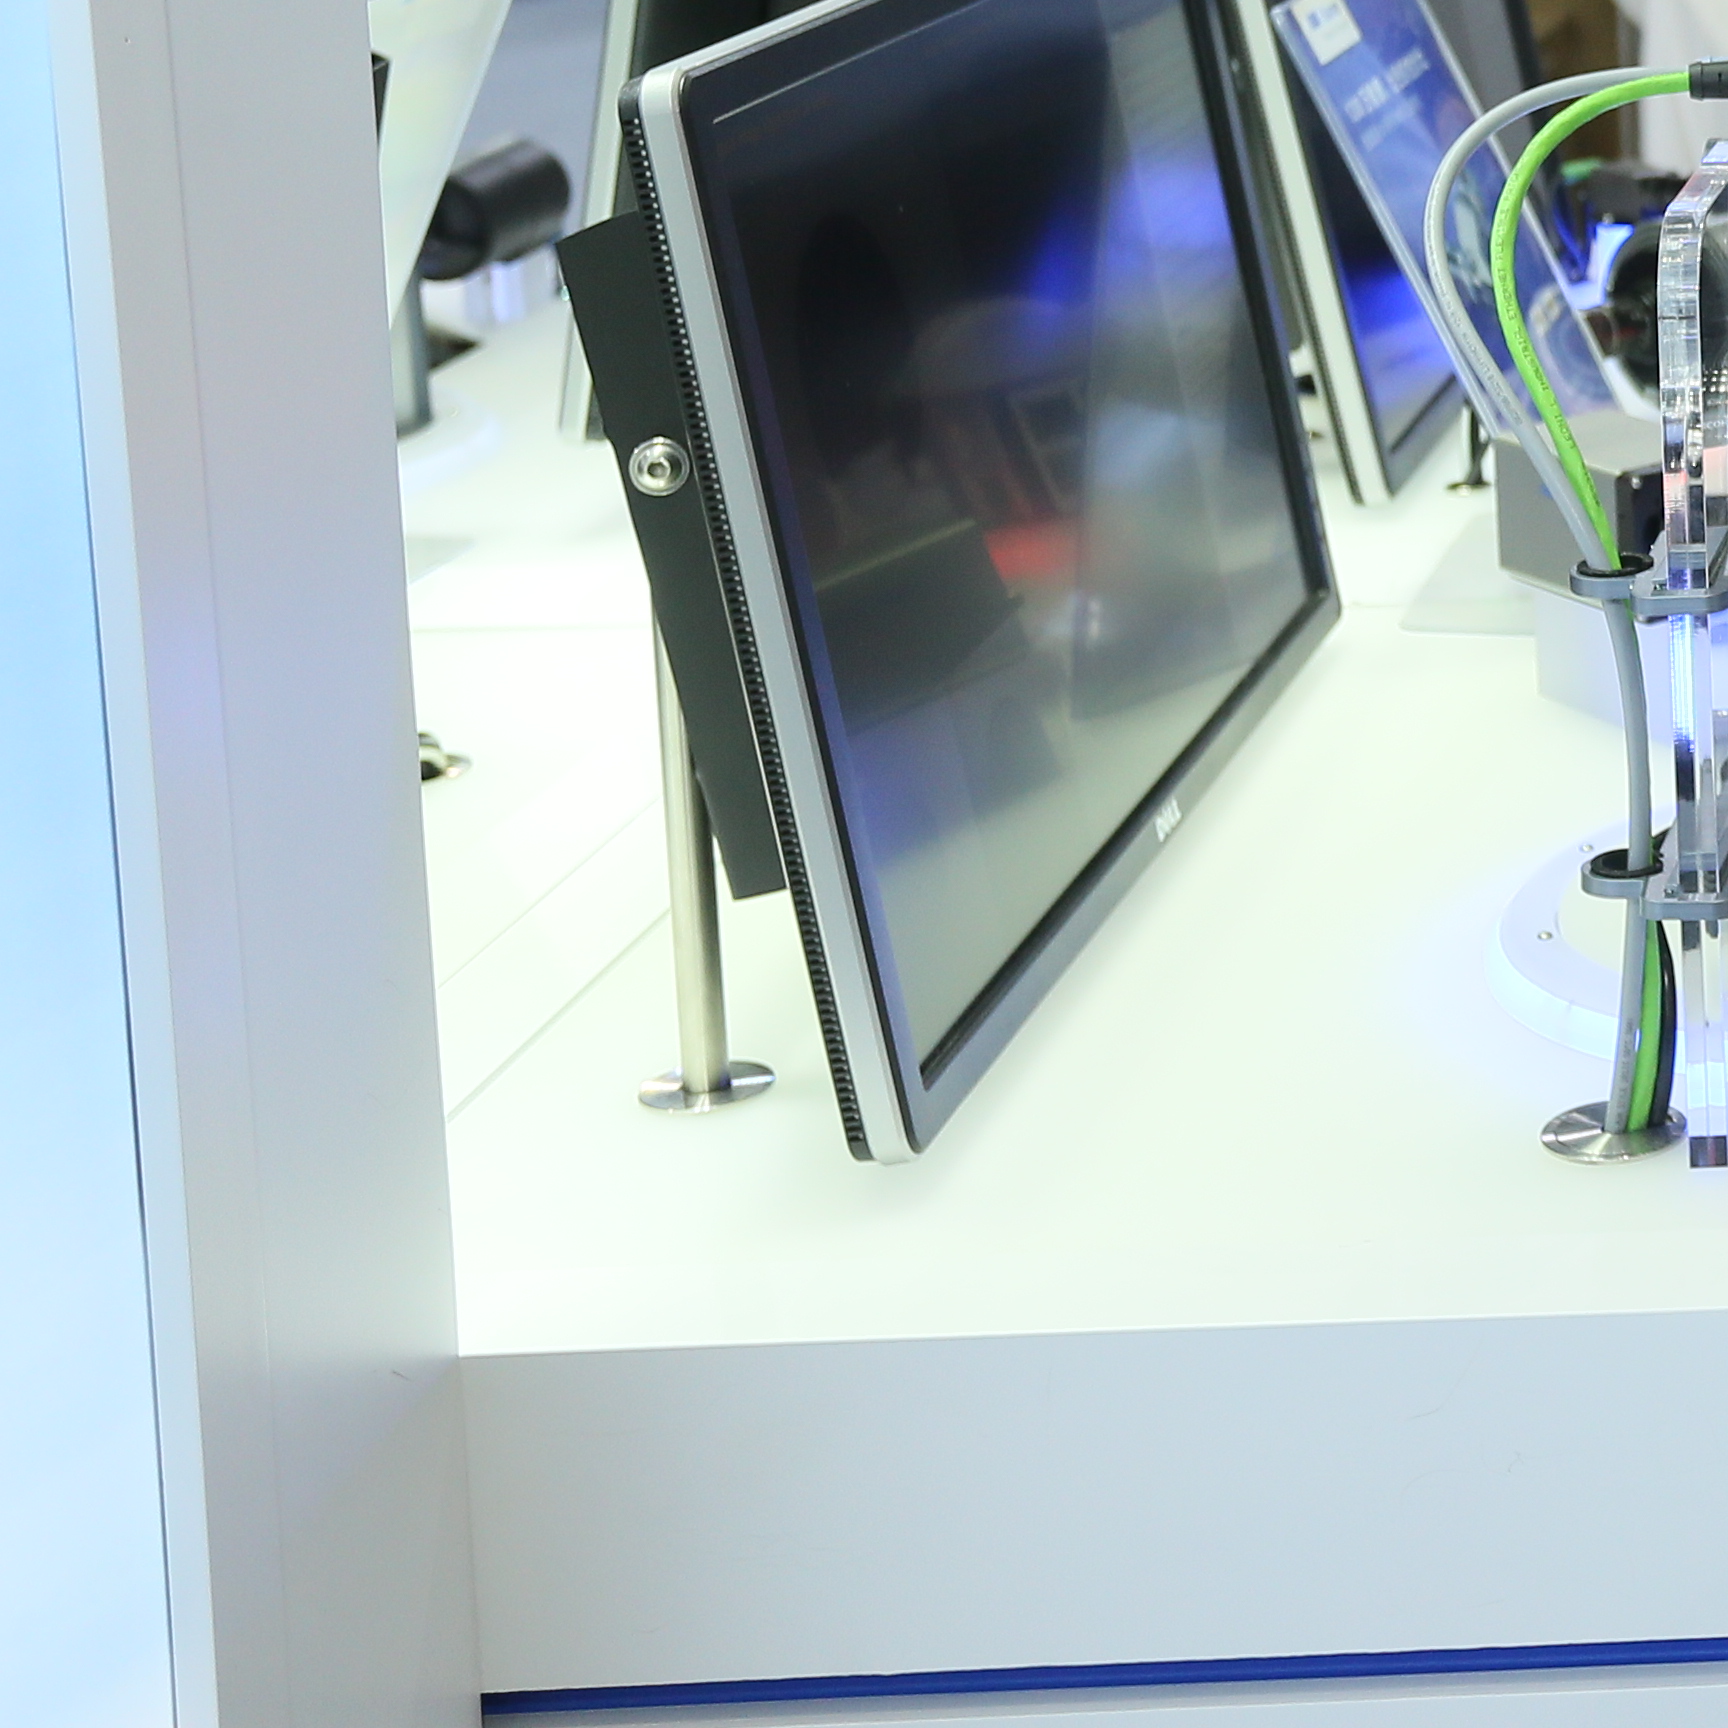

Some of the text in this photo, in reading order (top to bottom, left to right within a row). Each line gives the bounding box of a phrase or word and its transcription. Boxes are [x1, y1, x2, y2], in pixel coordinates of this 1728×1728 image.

[1497, 268, 1517, 321] ETHERNET
[1514, 325, 1549, 392] INDUSTRIAL
[1554, 413, 1576, 450] LEONI
